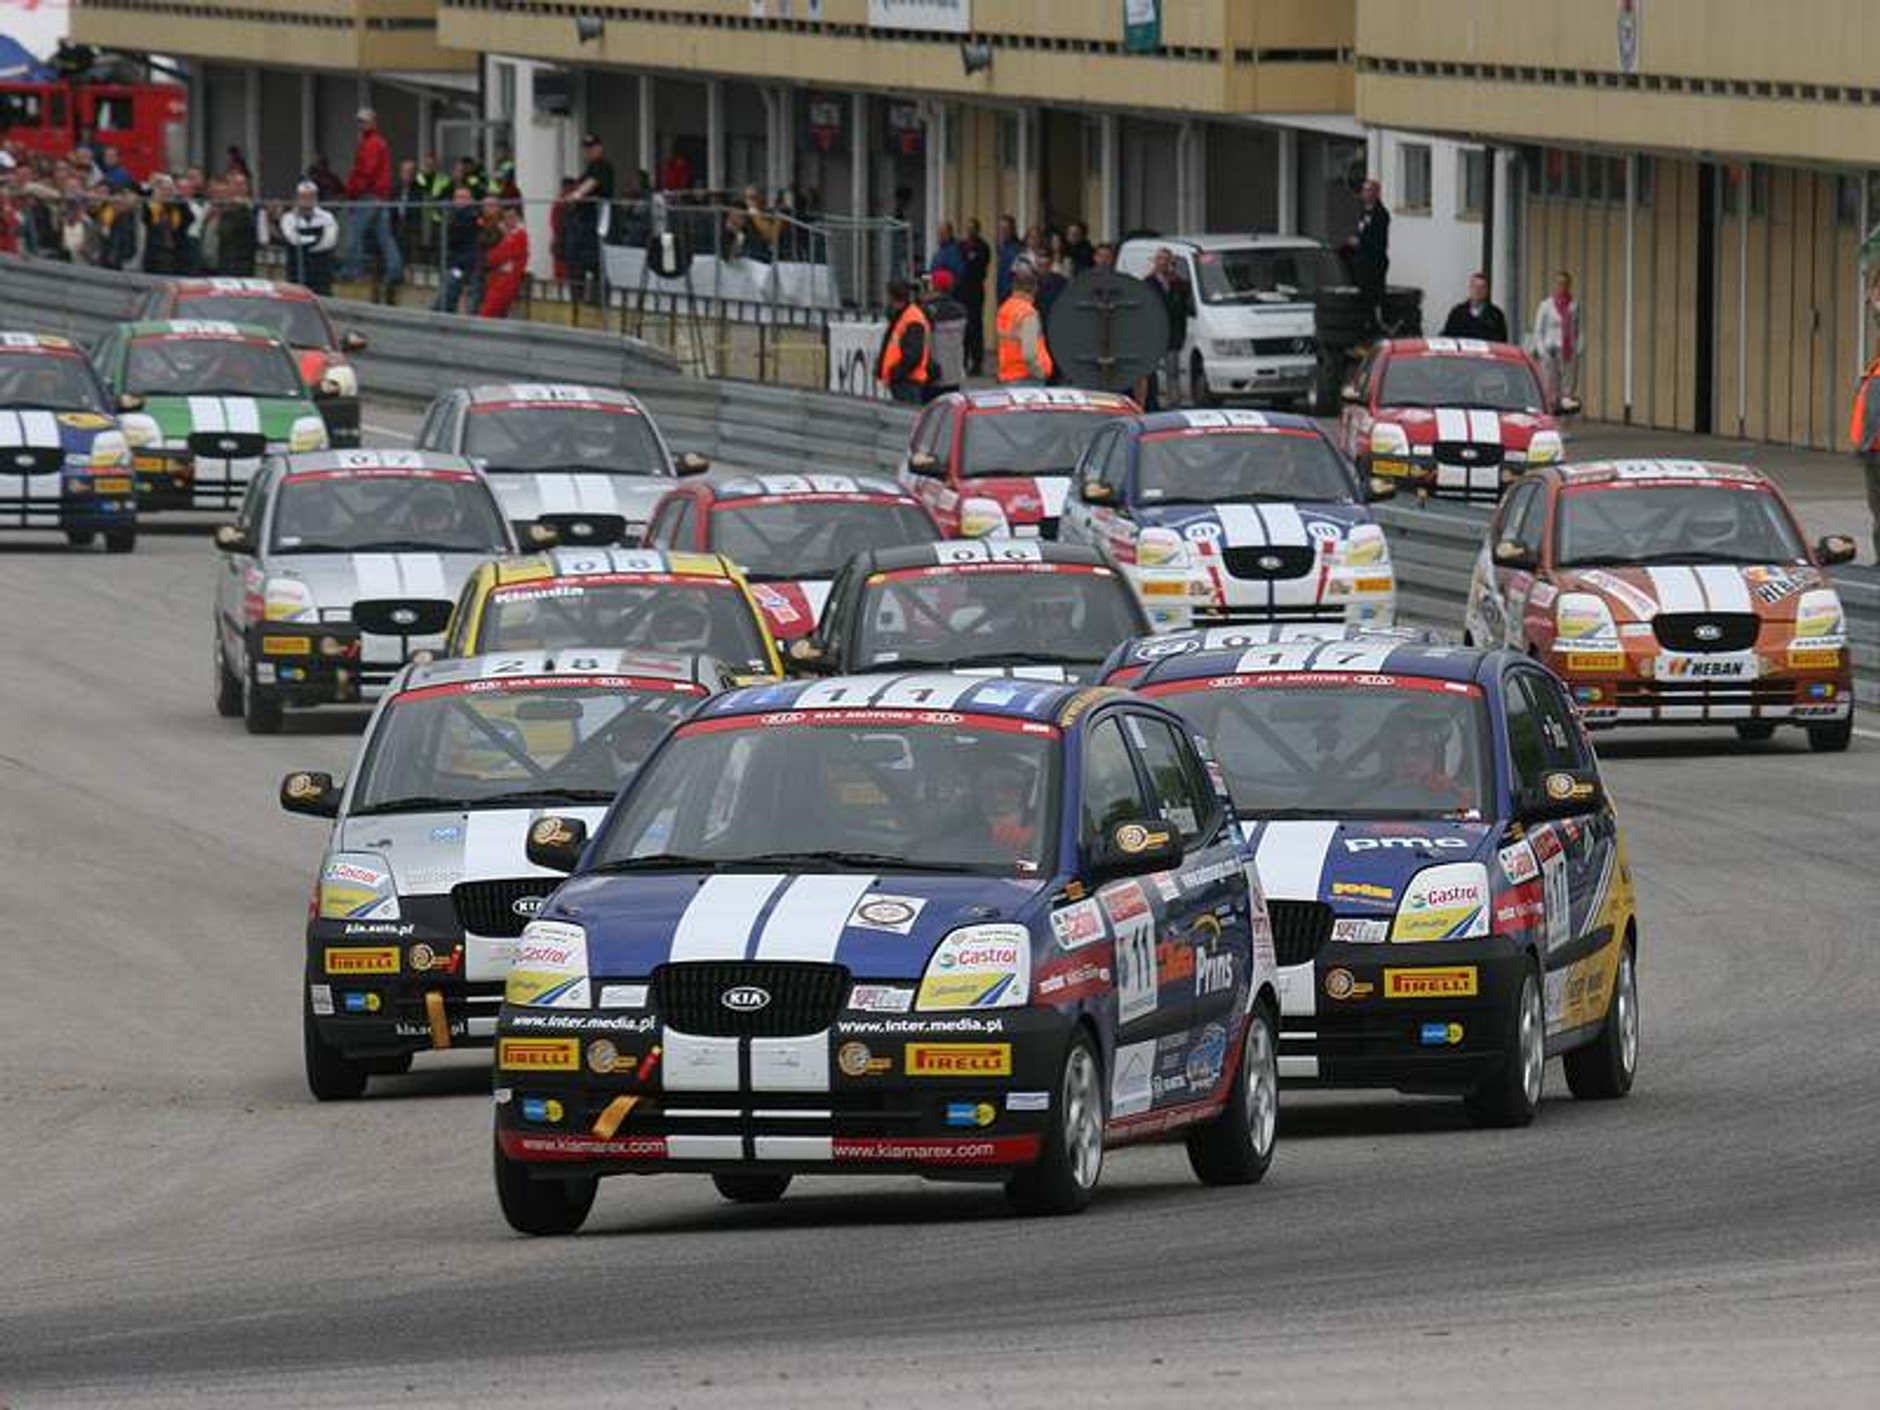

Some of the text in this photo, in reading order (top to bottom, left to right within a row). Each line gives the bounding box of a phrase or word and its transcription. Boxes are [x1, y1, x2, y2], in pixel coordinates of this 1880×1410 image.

[494, 585, 585, 602] Klaudia
[494, 660, 601, 672] 28
[1265, 652, 1366, 668] 17
[1691, 662, 1742, 675] HEBAN
[824, 686, 926, 704] 11
[1428, 886, 1479, 905] Castrol
[958, 947, 1017, 965] Castrol
[1393, 972, 1471, 992] PIRELLI
[728, 991, 763, 1005] KIA
[513, 1015, 656, 1034] www.inter.media.pl
[838, 1018, 1003, 1033] www.inter.media.pl
[505, 1044, 572, 1065] PIRELLI
[916, 1050, 1004, 1070] PIRELLI
[522, 1138, 665, 1153] www.kiamarex.com
[834, 1141, 994, 1160] www.kiamarex.com
